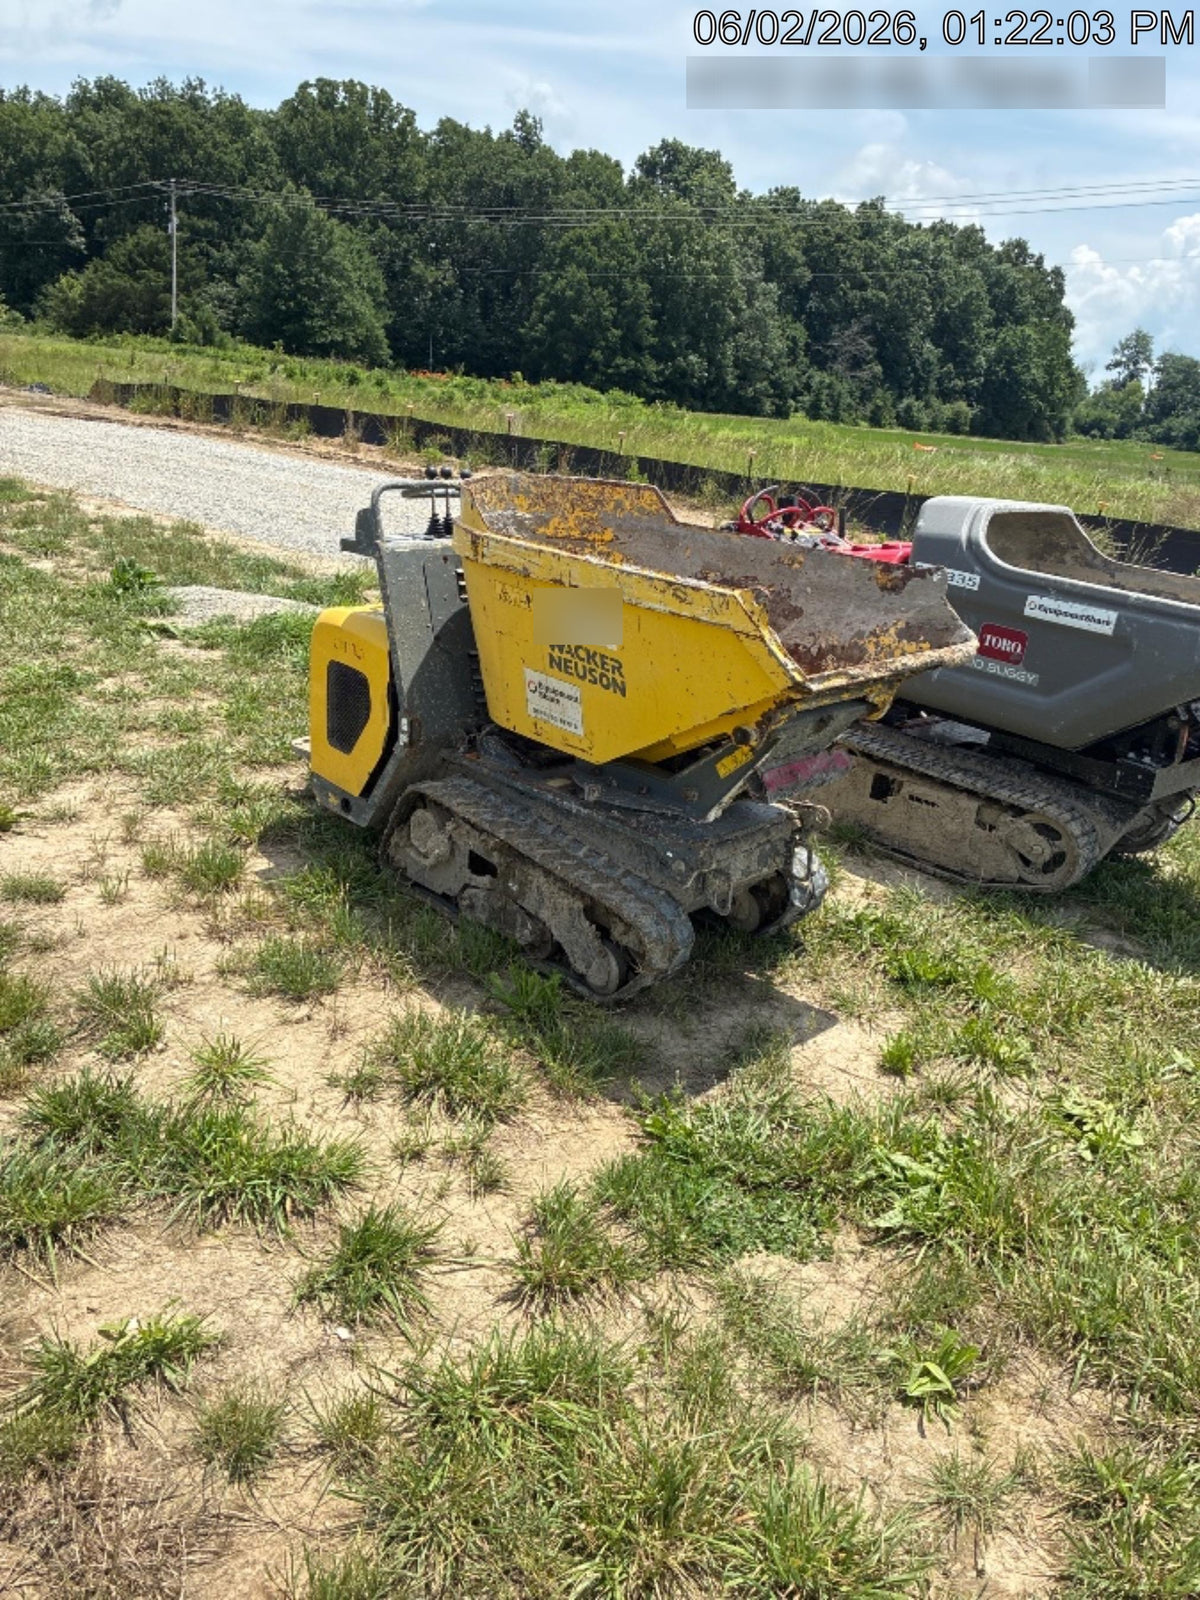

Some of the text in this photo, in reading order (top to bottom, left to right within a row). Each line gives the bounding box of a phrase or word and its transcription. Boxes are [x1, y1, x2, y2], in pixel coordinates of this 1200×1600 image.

[983, 633, 1024, 654] TORO
[548, 644, 625, 678] WACKER
[986, 662, 1037, 685] BUGGY
[548, 653, 627, 698] NEUSON
